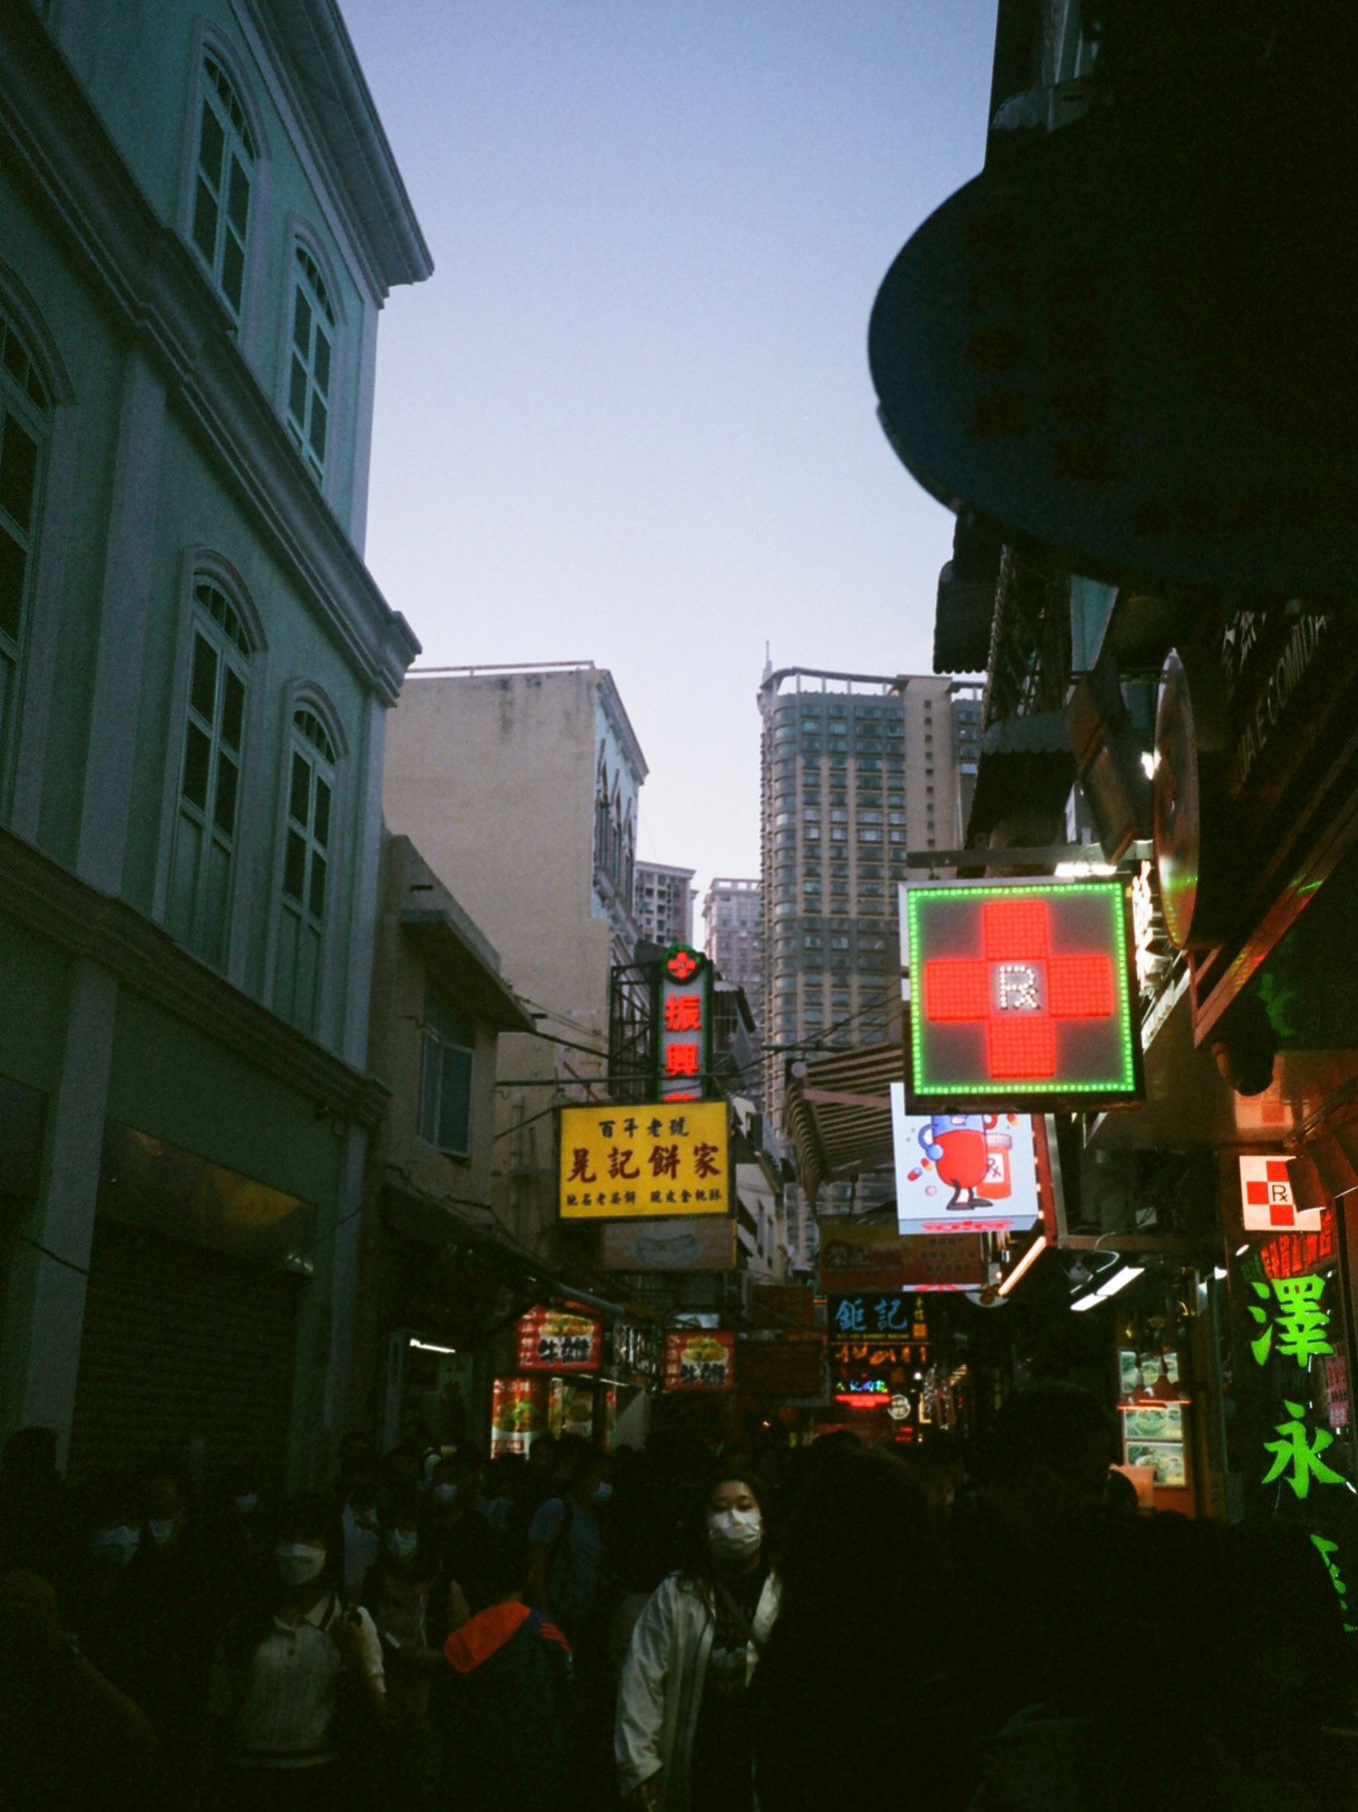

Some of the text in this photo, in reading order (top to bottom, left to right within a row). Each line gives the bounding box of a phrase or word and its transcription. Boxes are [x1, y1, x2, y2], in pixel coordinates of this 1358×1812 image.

[663, 994, 702, 1102] 振興
[598, 1116, 690, 1139] 百年老號
[567, 1142, 722, 1184] 晃記餅家
[834, 1297, 909, 1332] 鉅記
